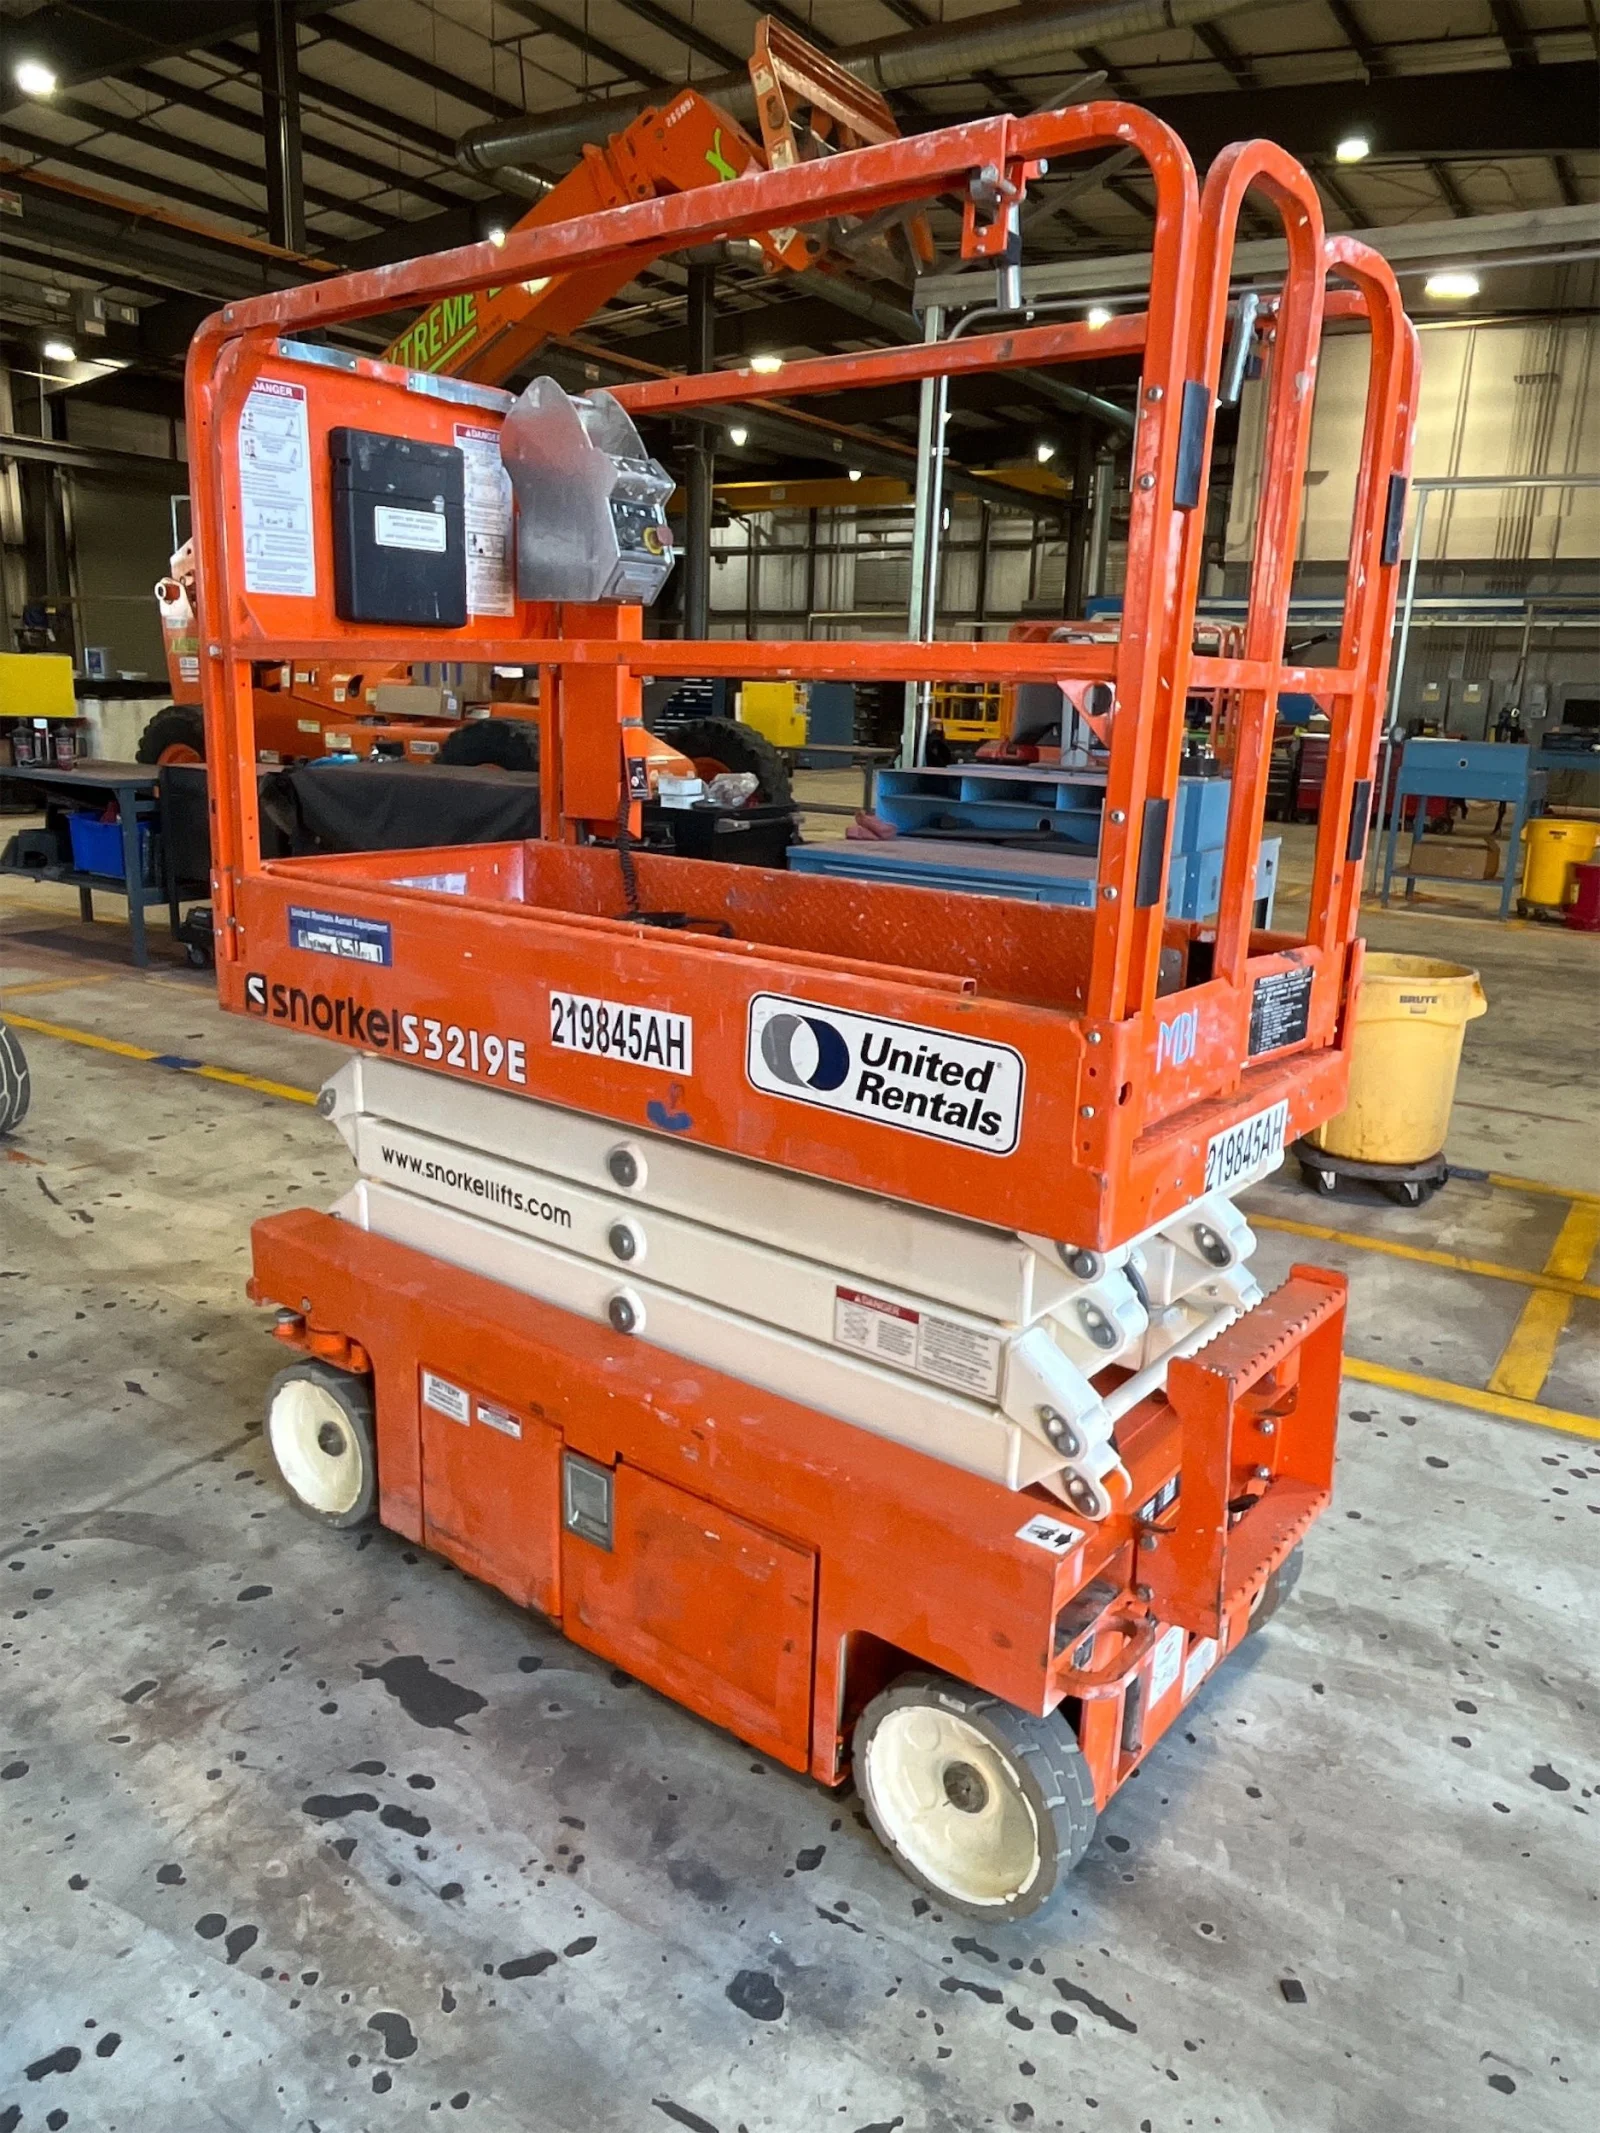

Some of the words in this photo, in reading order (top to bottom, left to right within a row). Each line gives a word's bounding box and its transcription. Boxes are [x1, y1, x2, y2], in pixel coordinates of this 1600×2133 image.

[272, 983, 400, 1051] snorkel
[401, 1014, 527, 1084] S3219E
[551, 997, 685, 1070] 219845AH
[1399, 995, 1438, 1005] BRUTE
[860, 1032, 995, 1094] United
[855, 1070, 1002, 1137] Rentals
[1205, 1106, 1286, 1193] 219845AH
[381, 1145, 572, 1229] www.snorkellifts.com
